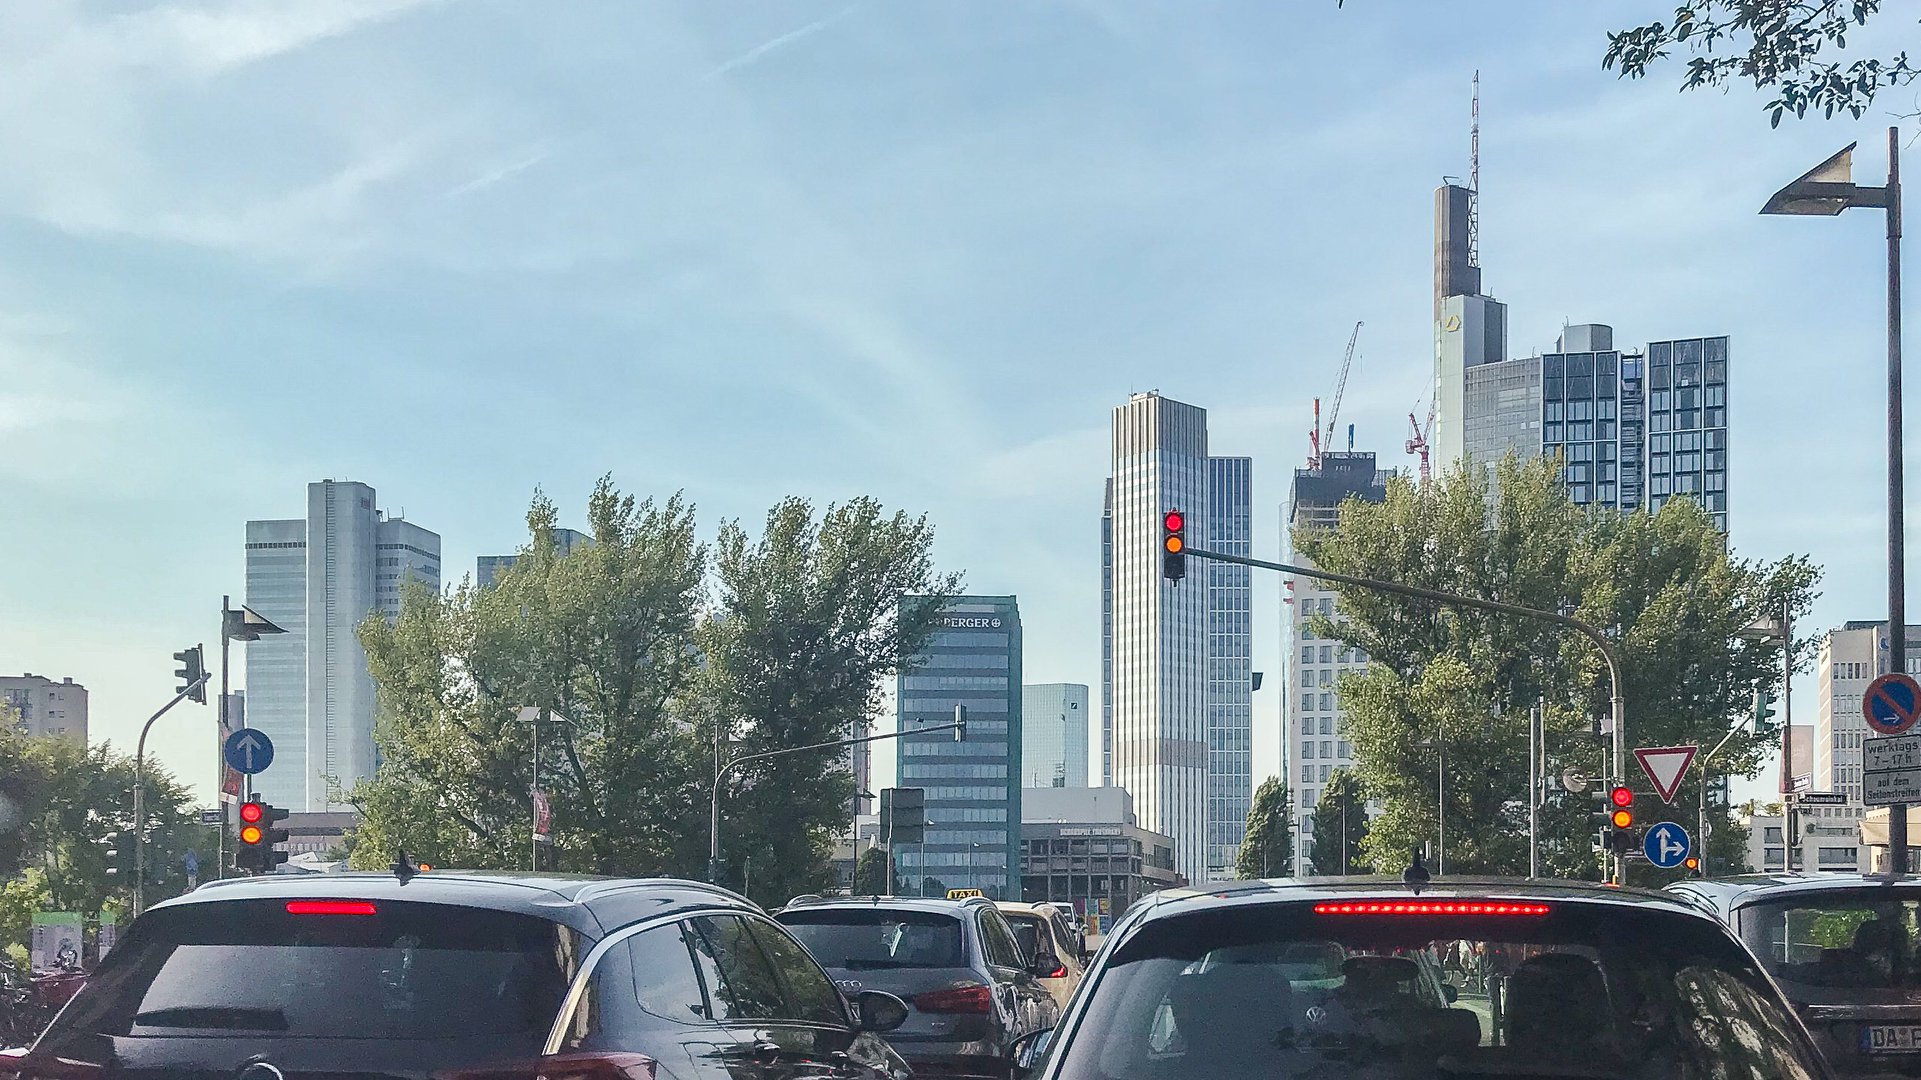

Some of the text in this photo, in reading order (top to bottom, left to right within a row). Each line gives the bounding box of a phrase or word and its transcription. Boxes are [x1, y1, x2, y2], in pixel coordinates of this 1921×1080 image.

[1867, 741, 1919, 754] werktags
[1873, 755, 1880, 766] 7
[1892, 754, 1903, 765] 17
[1905, 753, 1912, 763] h
[1877, 776, 1909, 787] auf dem
[1867, 788, 1921, 799] Seitenstreifen
[952, 890, 977, 898] TAXI
[1873, 1028, 1898, 1047] DA
